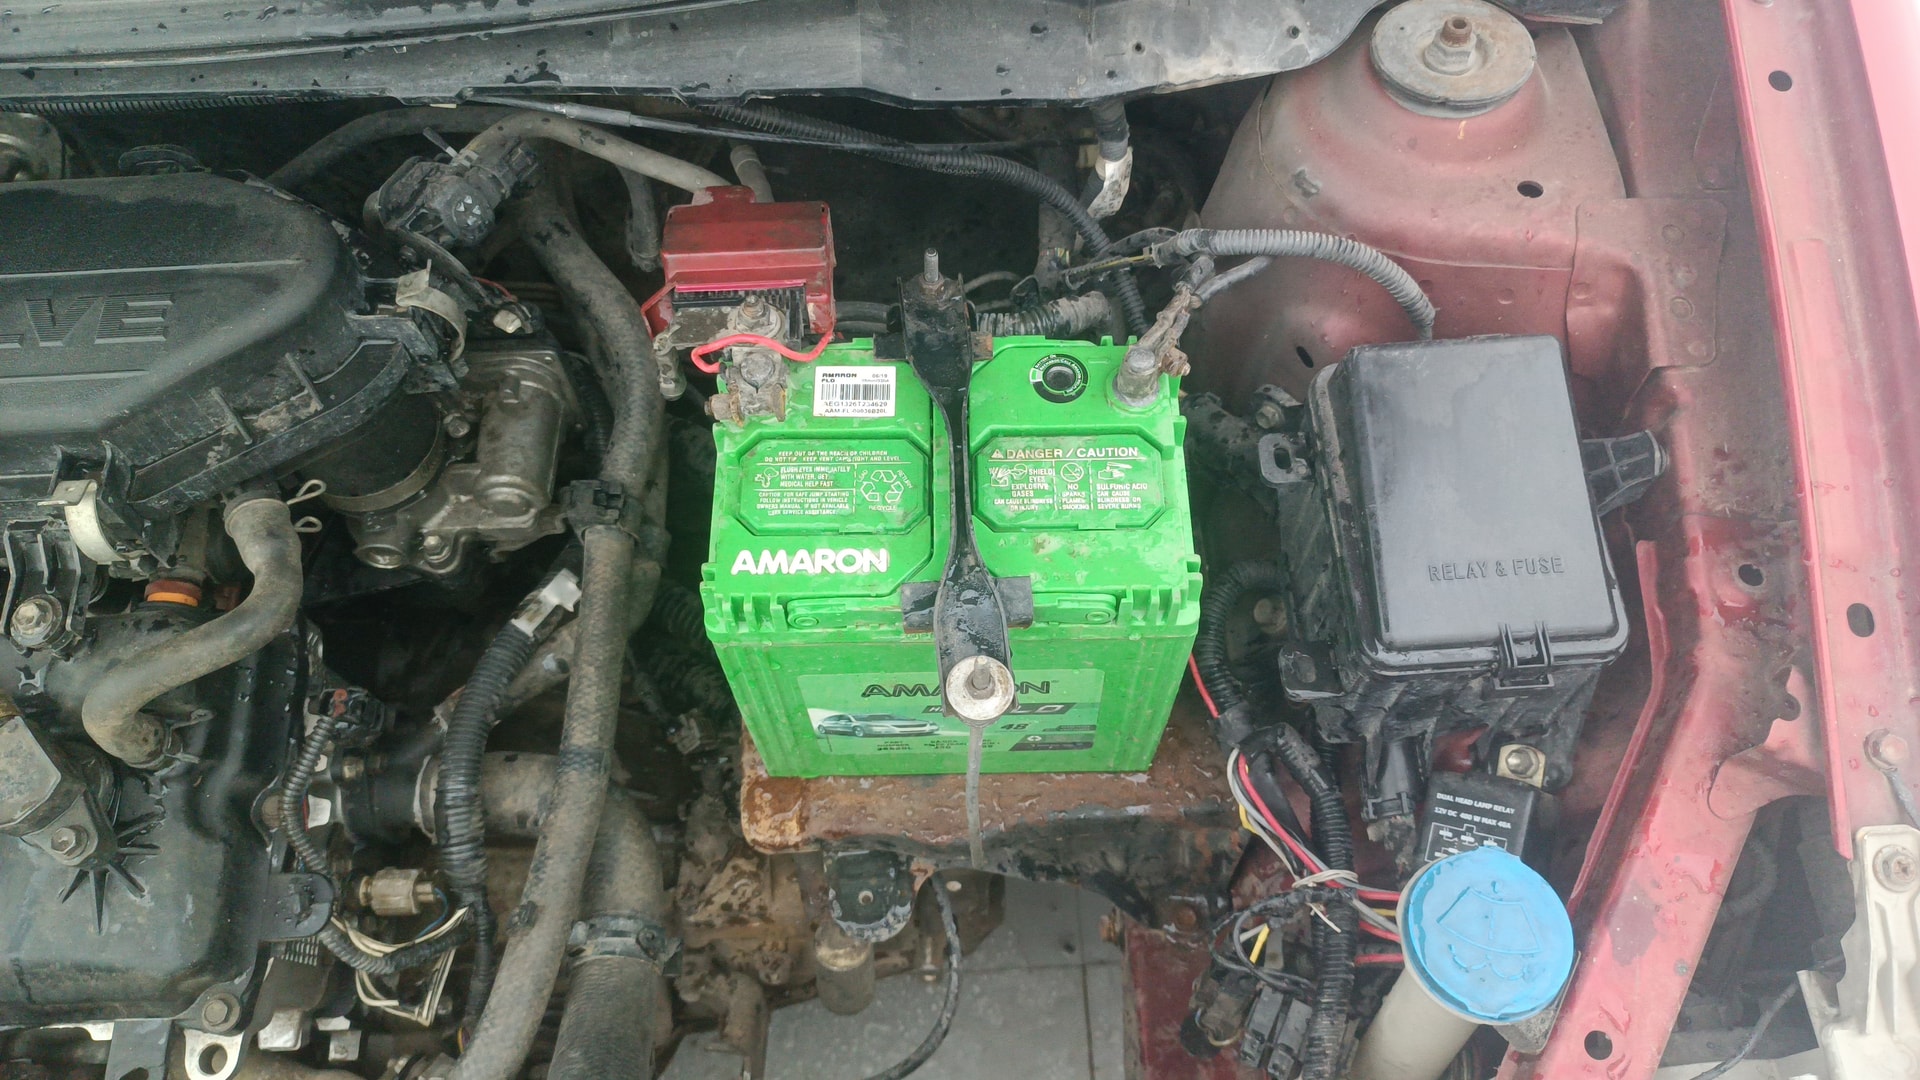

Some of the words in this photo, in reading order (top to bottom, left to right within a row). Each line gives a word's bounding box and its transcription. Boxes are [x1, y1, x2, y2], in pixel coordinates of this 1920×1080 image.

[1006, 448, 1063, 459] DANGER
[1076, 446, 1138, 458] CAUTION
[730, 547, 888, 576] AMARON
[1428, 560, 1488, 582] RELAY
[1495, 560, 1508, 577] &
[1512, 556, 1565, 576] FUSE
[861, 680, 1051, 698] AMN
[1436, 792, 1454, 802] DUAL
[1455, 796, 1473, 806] HEAD
[1474, 800, 1493, 810] LAMP
[1493, 804, 1515, 814] RELAY
[1434, 806, 1447, 815] 12V
[1447, 809, 1458, 817] DC
[1481, 817, 1498, 826] MAX
